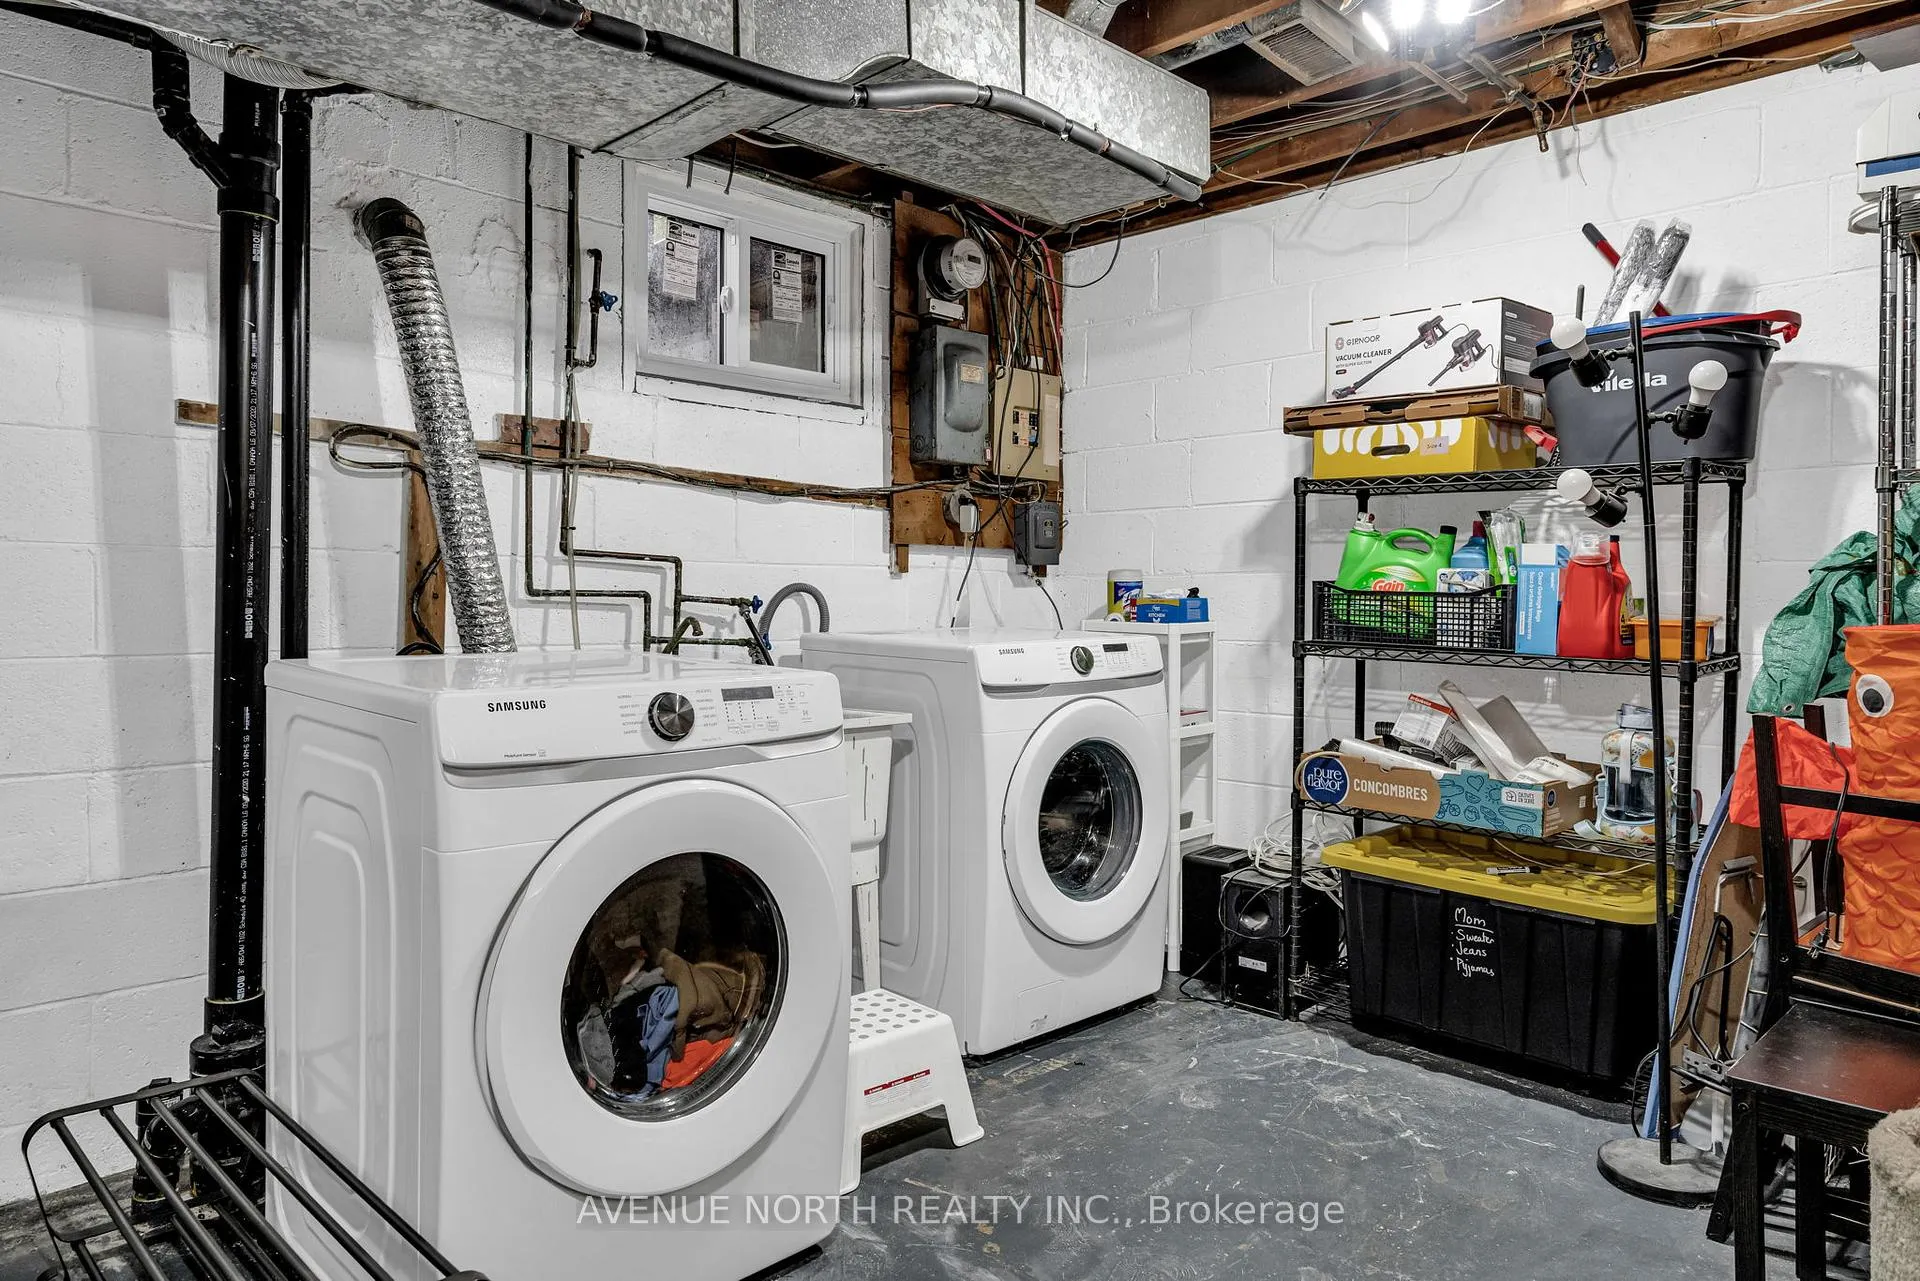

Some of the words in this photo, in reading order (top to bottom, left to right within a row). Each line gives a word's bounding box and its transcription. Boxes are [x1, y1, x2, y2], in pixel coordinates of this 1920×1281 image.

[1335, 352, 1362, 362] VACUUM
[1363, 348, 1393, 359] CLEANER
[999, 647, 1025, 655] SAMSUNG
[487, 700, 547, 712] SAMSUNG
[1313, 767, 1343, 781] pure
[1353, 778, 1428, 802] CONCOMBRES
[1454, 907, 1486, 927] Mom
[1456, 929, 1495, 944] Sweater
[1456, 941, 1487, 957] Jeans
[1456, 957, 1495, 978] Pyjamas
